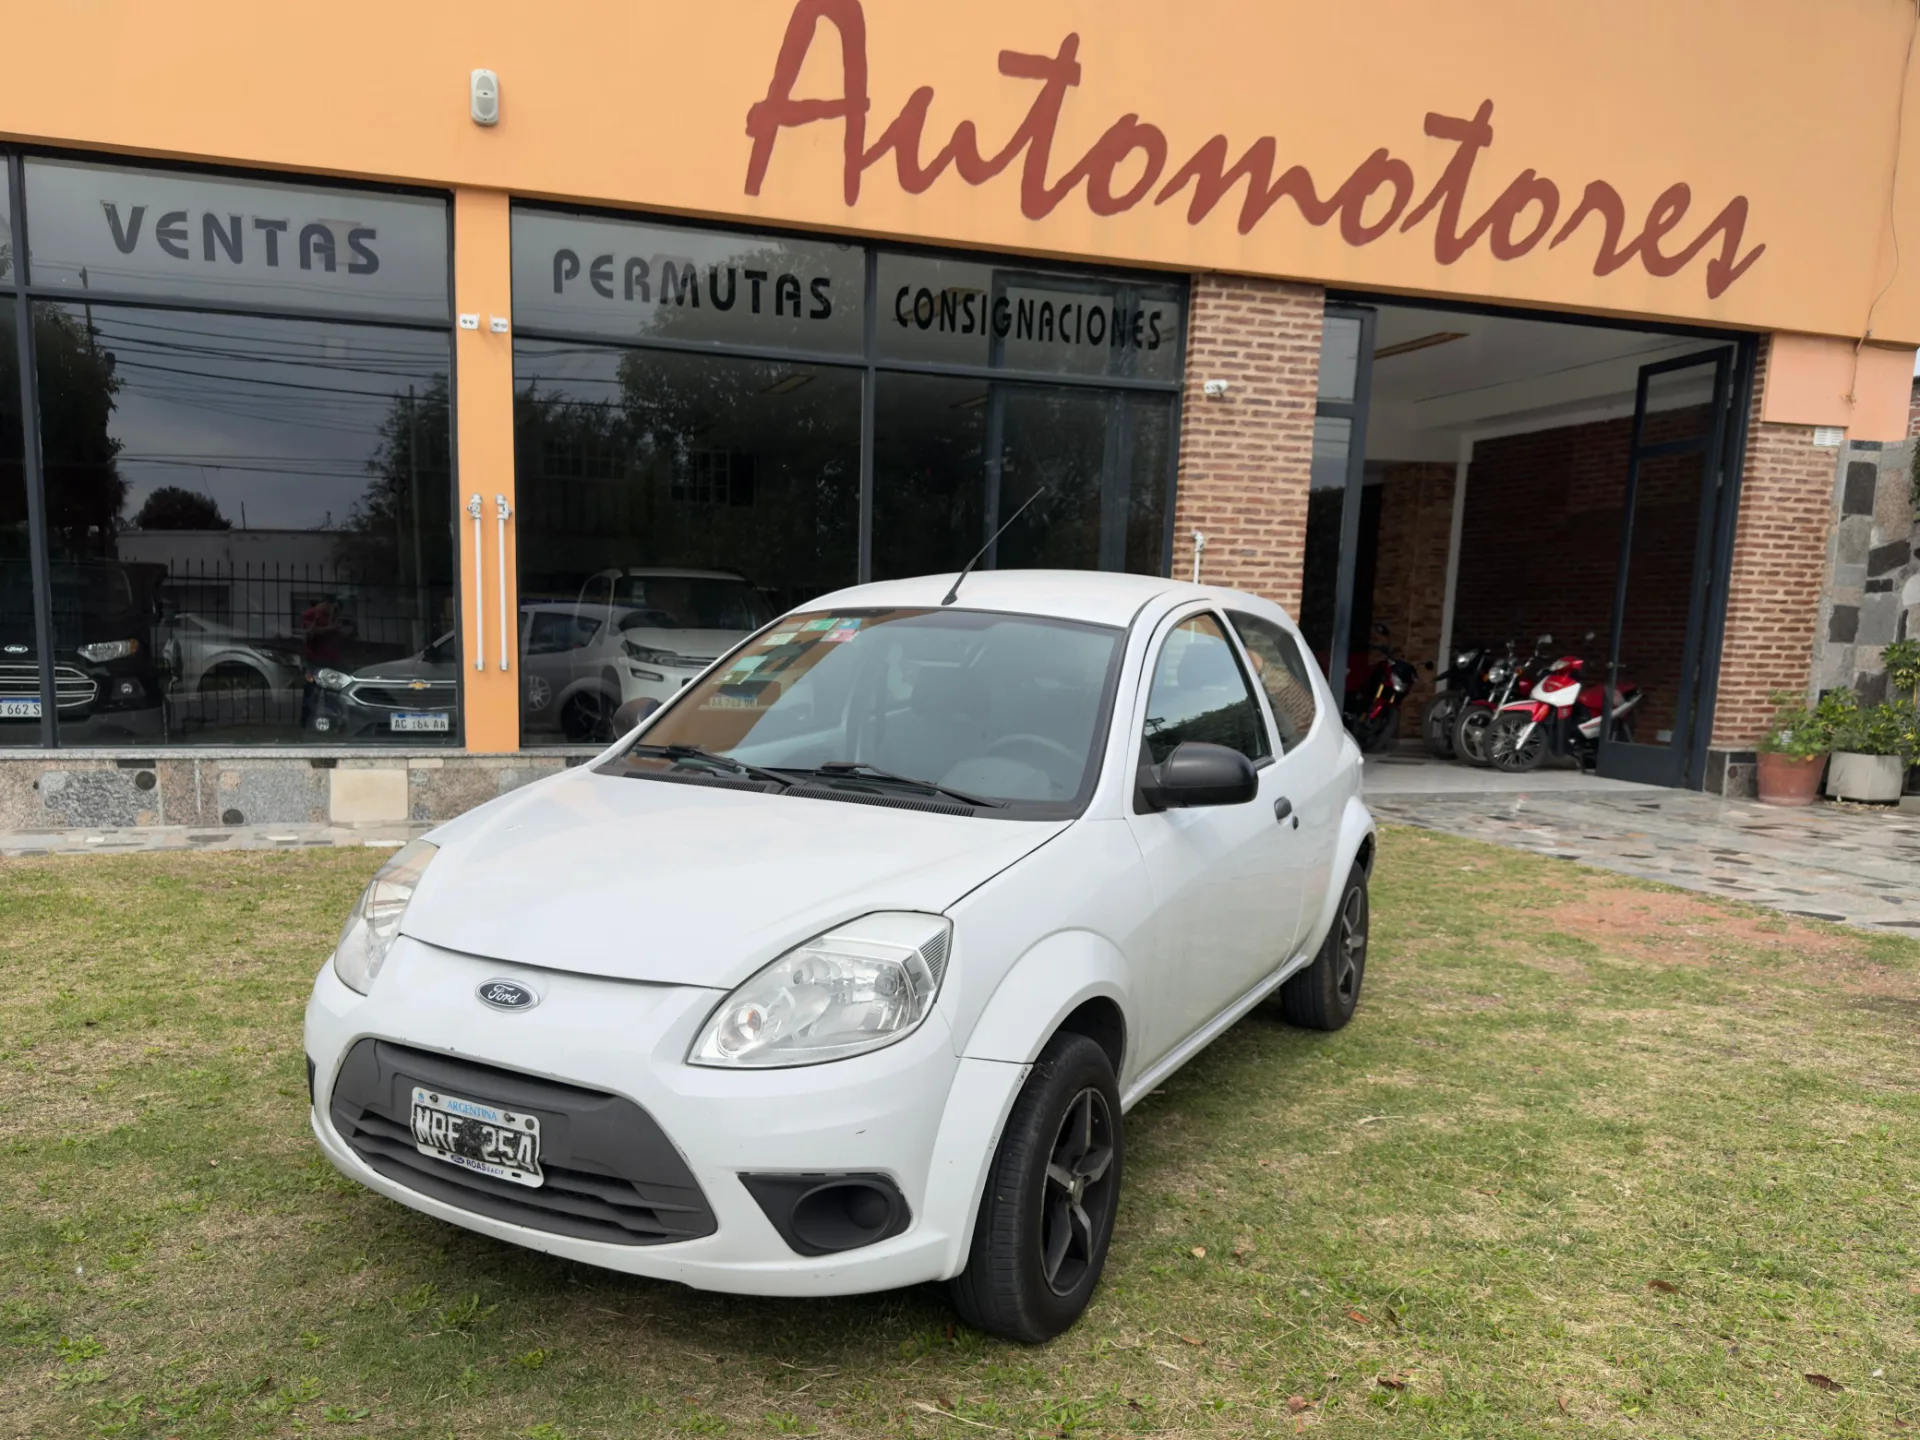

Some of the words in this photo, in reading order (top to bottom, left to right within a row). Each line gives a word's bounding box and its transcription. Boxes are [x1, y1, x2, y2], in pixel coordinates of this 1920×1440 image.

[744, 0, 1766, 299] Automotores
[100, 200, 380, 275] VENTAS
[552, 248, 832, 320] PERMUTAS
[895, 285, 1162, 351] CONSIGNACIONES
[7, 704, 29, 715] 662
[487, 984, 521, 1004] Ford
[415, 1105, 464, 1152] MRF
[447, 1099, 498, 1121] ARGENTINA
